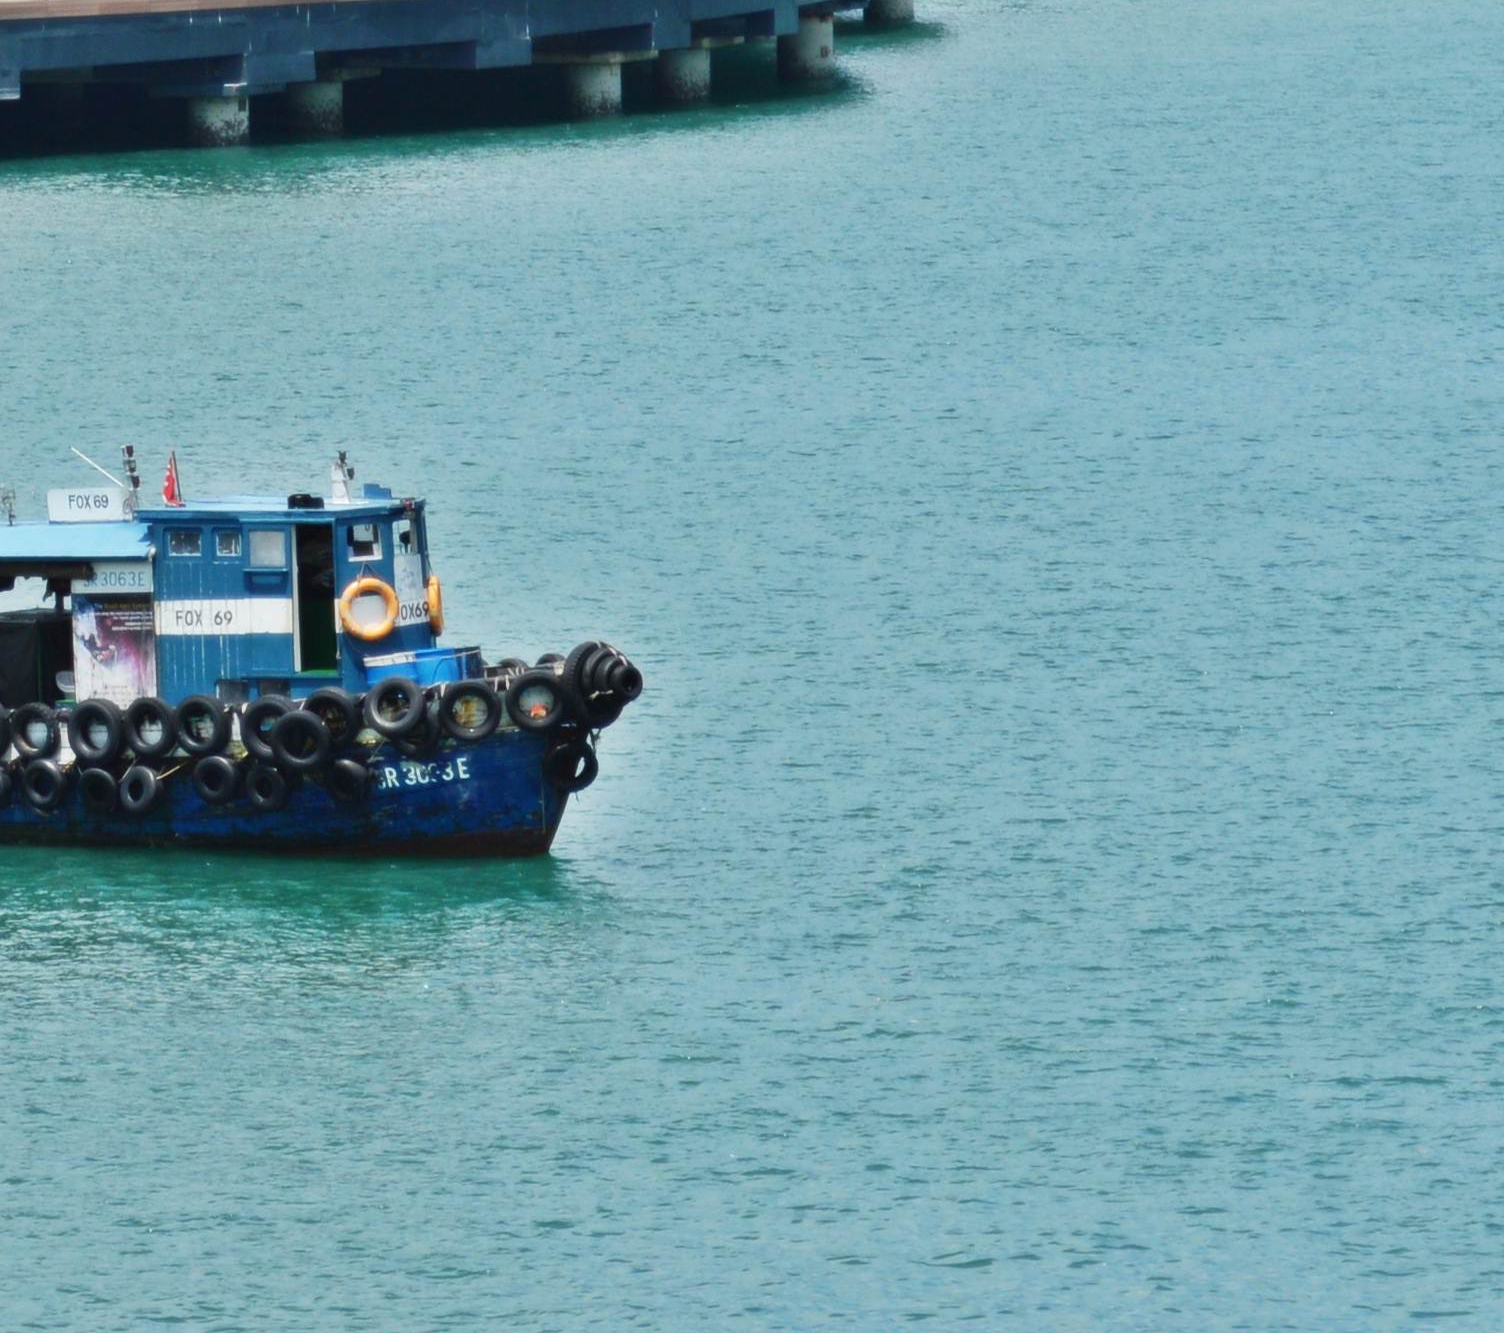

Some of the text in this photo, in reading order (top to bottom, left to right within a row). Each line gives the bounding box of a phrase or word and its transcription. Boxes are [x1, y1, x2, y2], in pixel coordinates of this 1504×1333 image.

[68, 494, 109, 509] FOX 69
[176, 610, 233, 626] FOX 69
